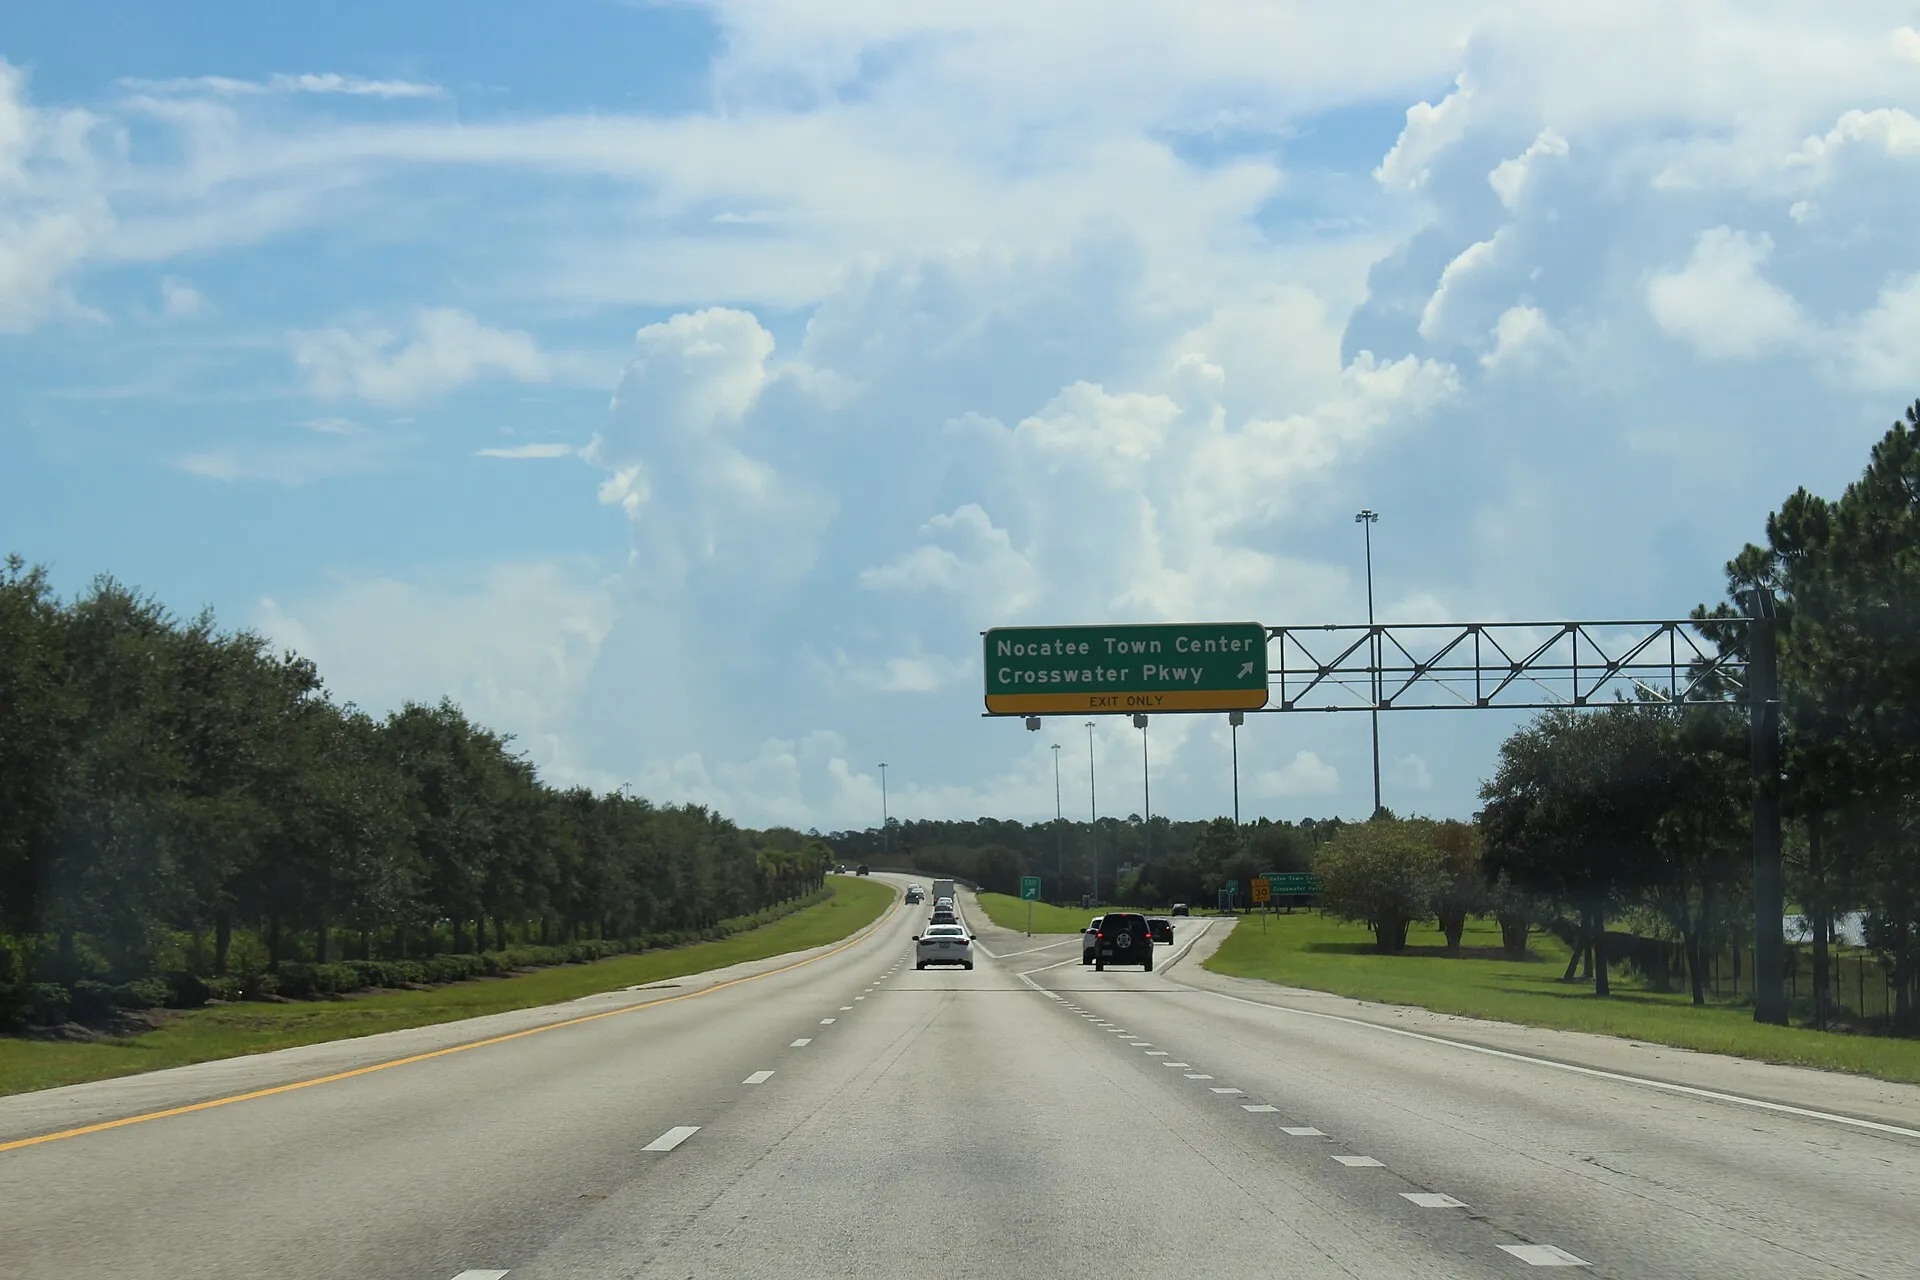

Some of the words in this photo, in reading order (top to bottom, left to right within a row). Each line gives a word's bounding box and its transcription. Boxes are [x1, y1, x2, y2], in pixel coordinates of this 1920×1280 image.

[997, 639, 1090, 657] Nocatee
[1103, 637, 1162, 654] Town
[1175, 635, 1253, 653] Center
[998, 665, 1129, 684] Crosswater
[1143, 664, 1203, 684] Pkwy
[1090, 696, 1119, 707] EXIT
[1127, 695, 1163, 706] ONLY
[1255, 887, 1268, 896] 30
